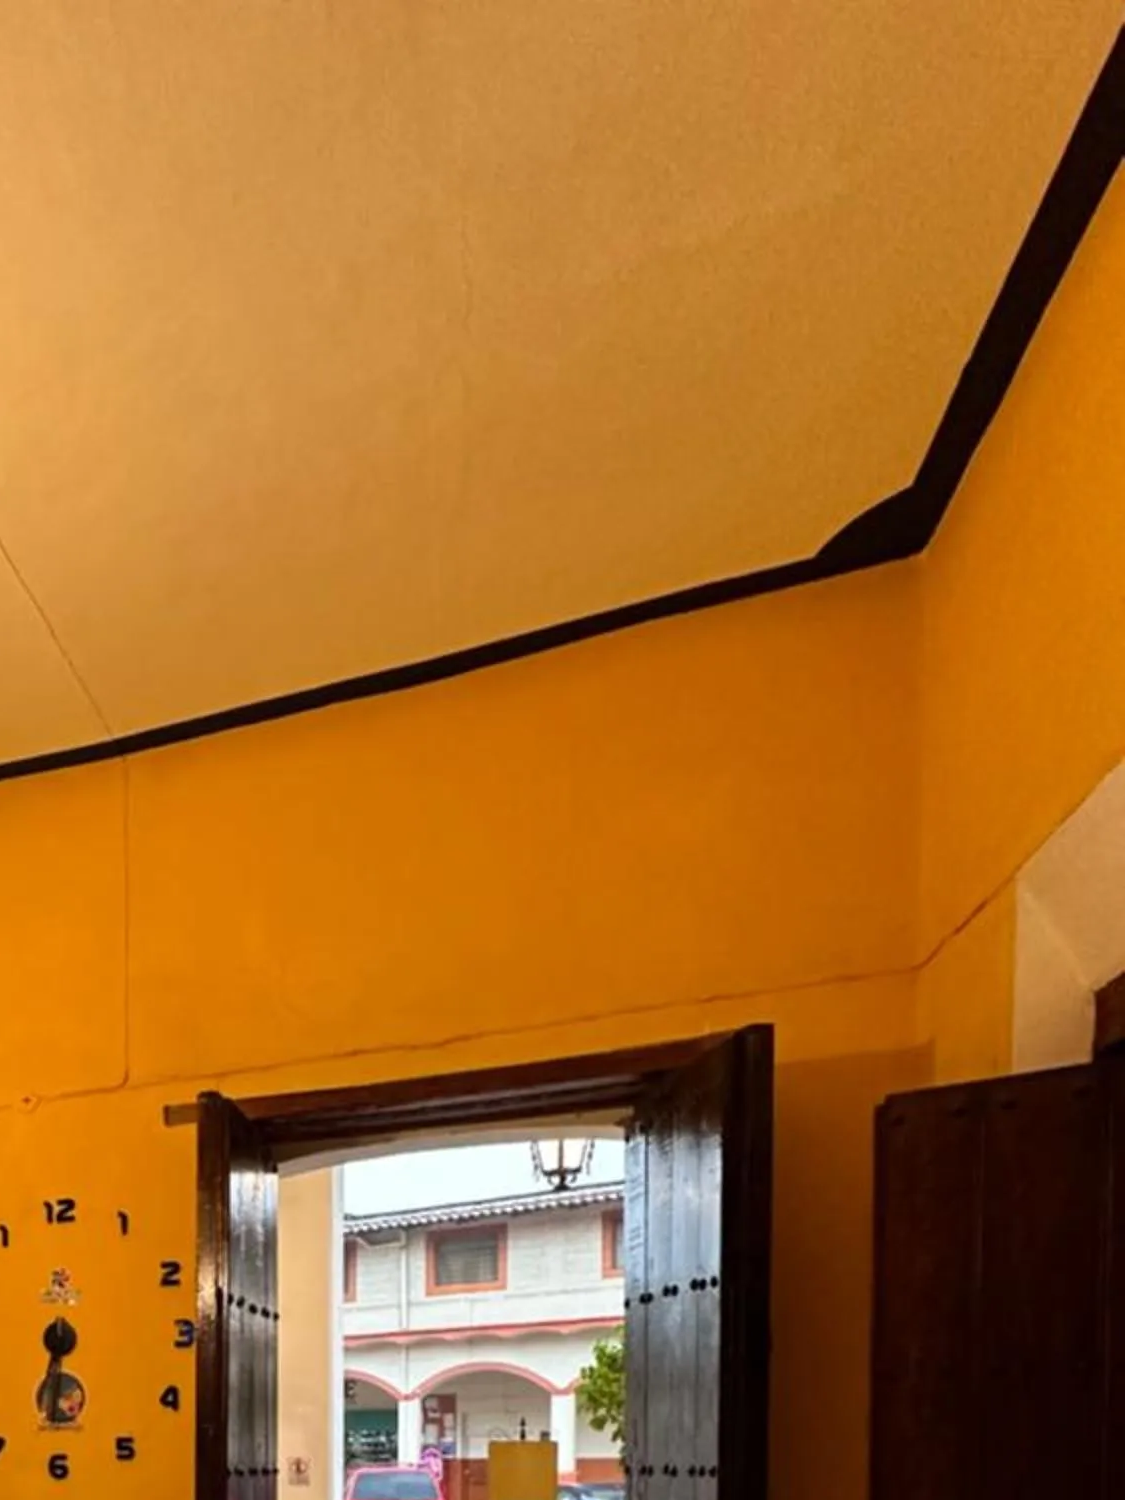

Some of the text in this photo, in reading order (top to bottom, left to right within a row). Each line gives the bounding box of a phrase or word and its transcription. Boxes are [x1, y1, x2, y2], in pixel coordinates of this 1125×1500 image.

[43, 1198, 76, 1225] 12
[117, 1211, 129, 1236] 1
[159, 1260, 182, 1288] 2
[173, 1318, 195, 1350] 3
[158, 1384, 181, 1413] 4
[114, 1436, 137, 1462] 5
[47, 1453, 70, 1482] 6
